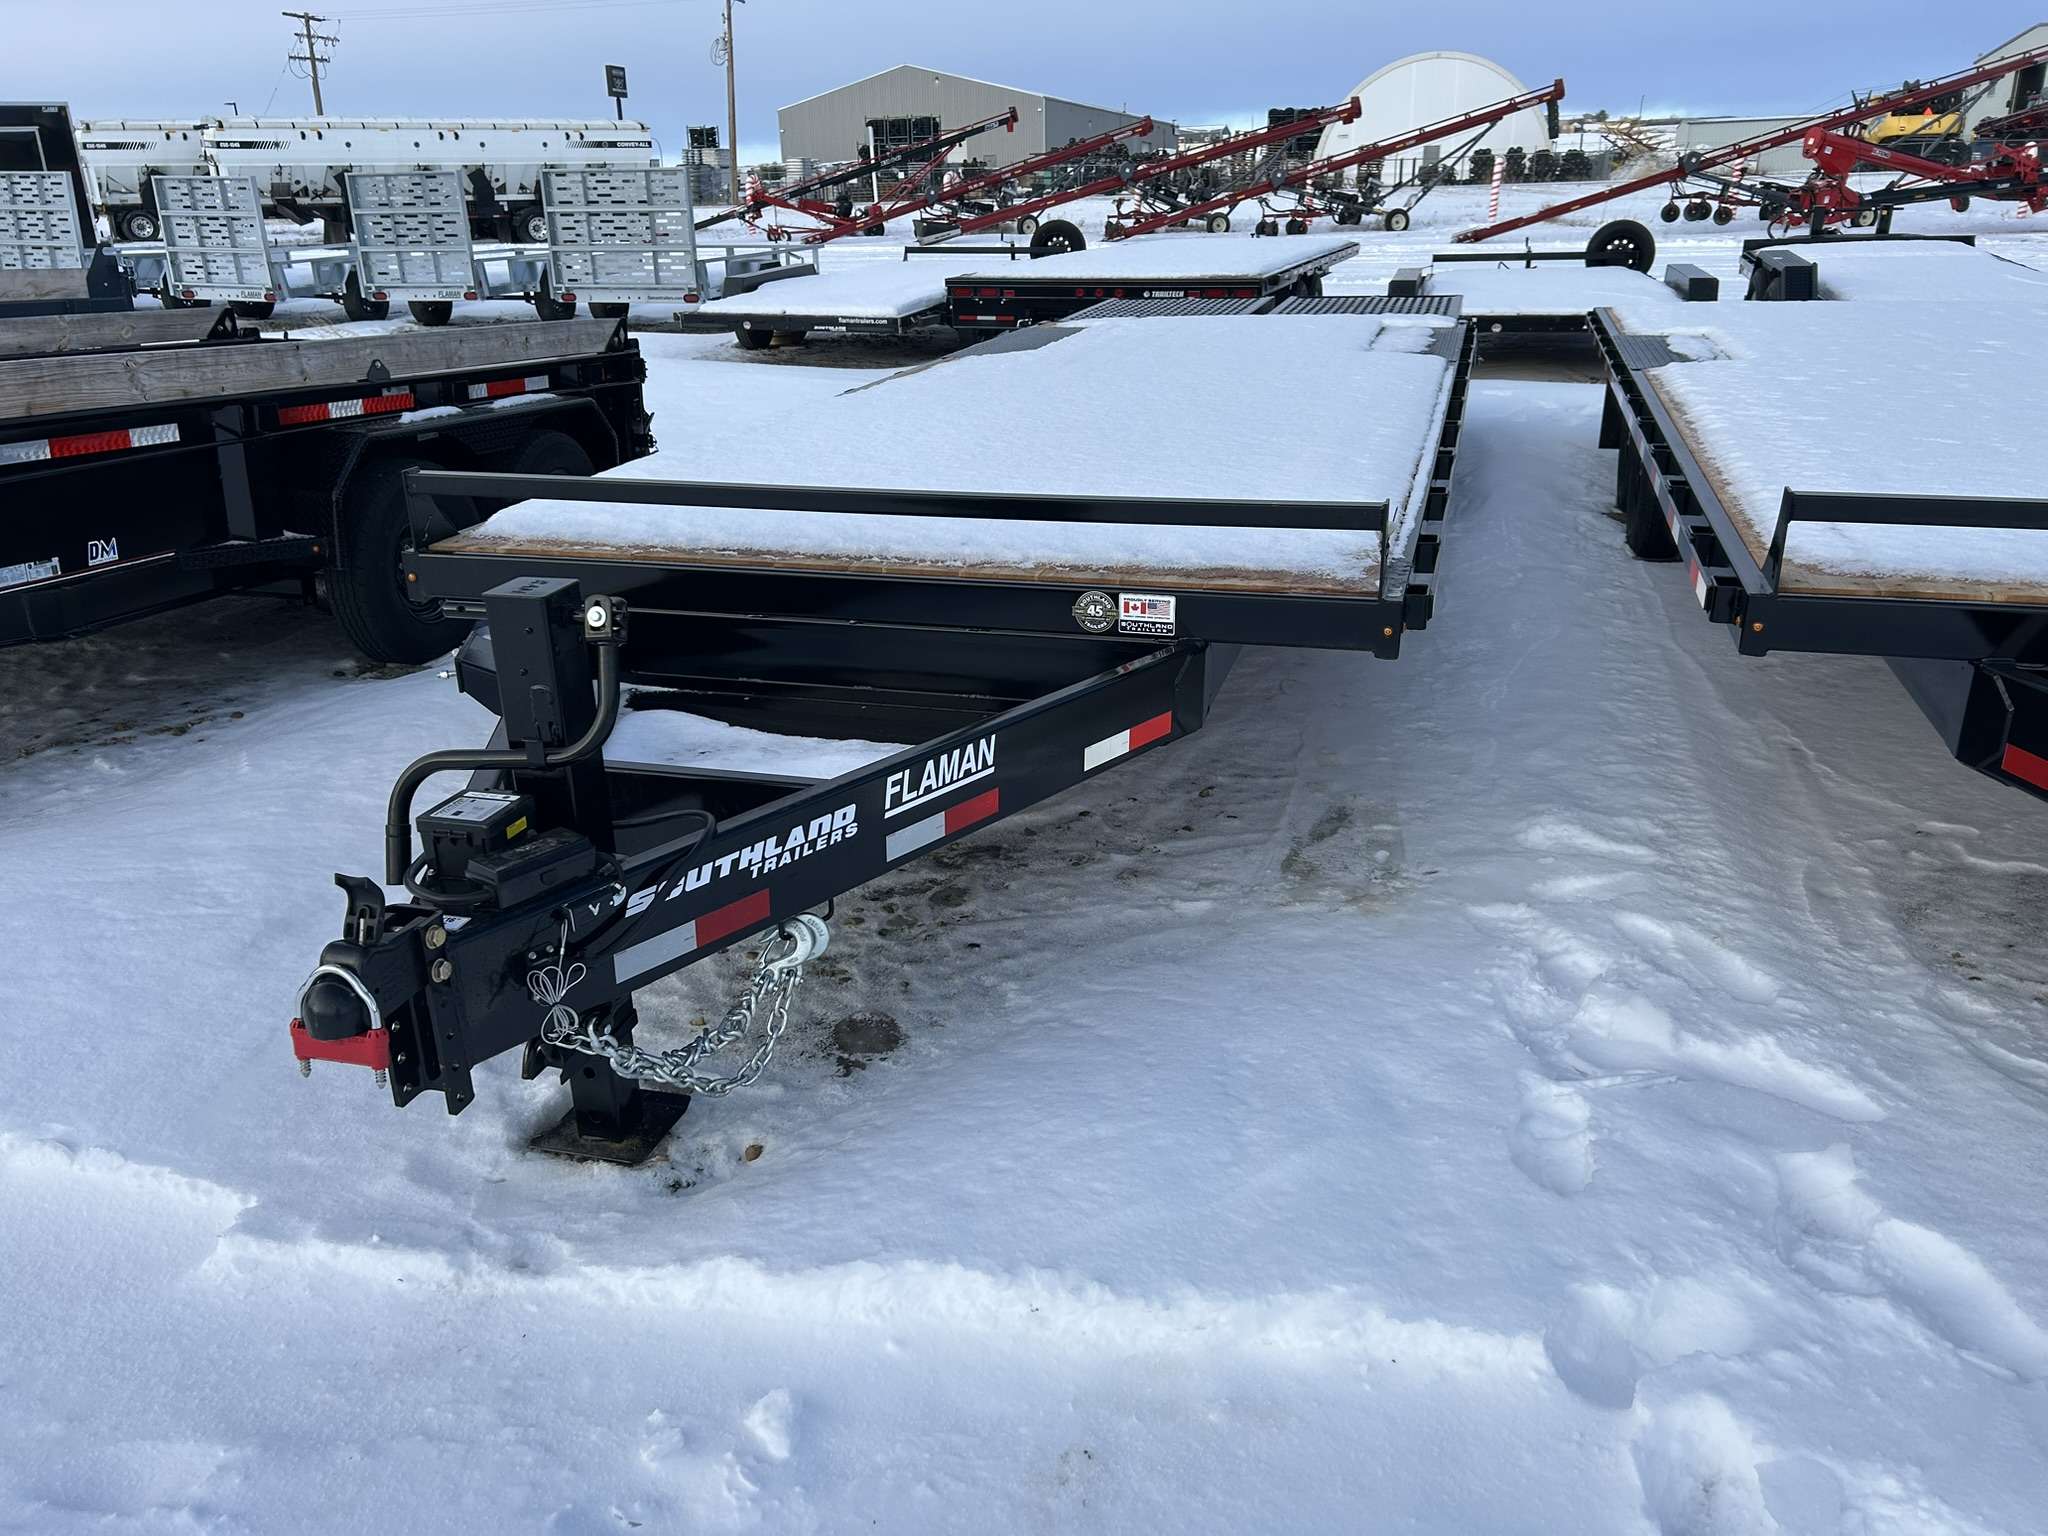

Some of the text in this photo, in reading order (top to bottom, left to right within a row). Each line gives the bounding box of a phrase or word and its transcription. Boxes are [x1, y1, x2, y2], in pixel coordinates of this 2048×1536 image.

[1151, 290, 1185, 298] TRAILTECH
[838, 317, 888, 325] flamantrailers.com
[1080, 595, 1112, 609] SOUTHLAND
[1087, 605, 1103, 617] 45
[1084, 620, 1108, 630] TRAILERS
[1120, 621, 1173, 630] SOUTHLAND
[884, 733, 997, 812] FLAMAN
[750, 822, 859, 879] TRAILERS
